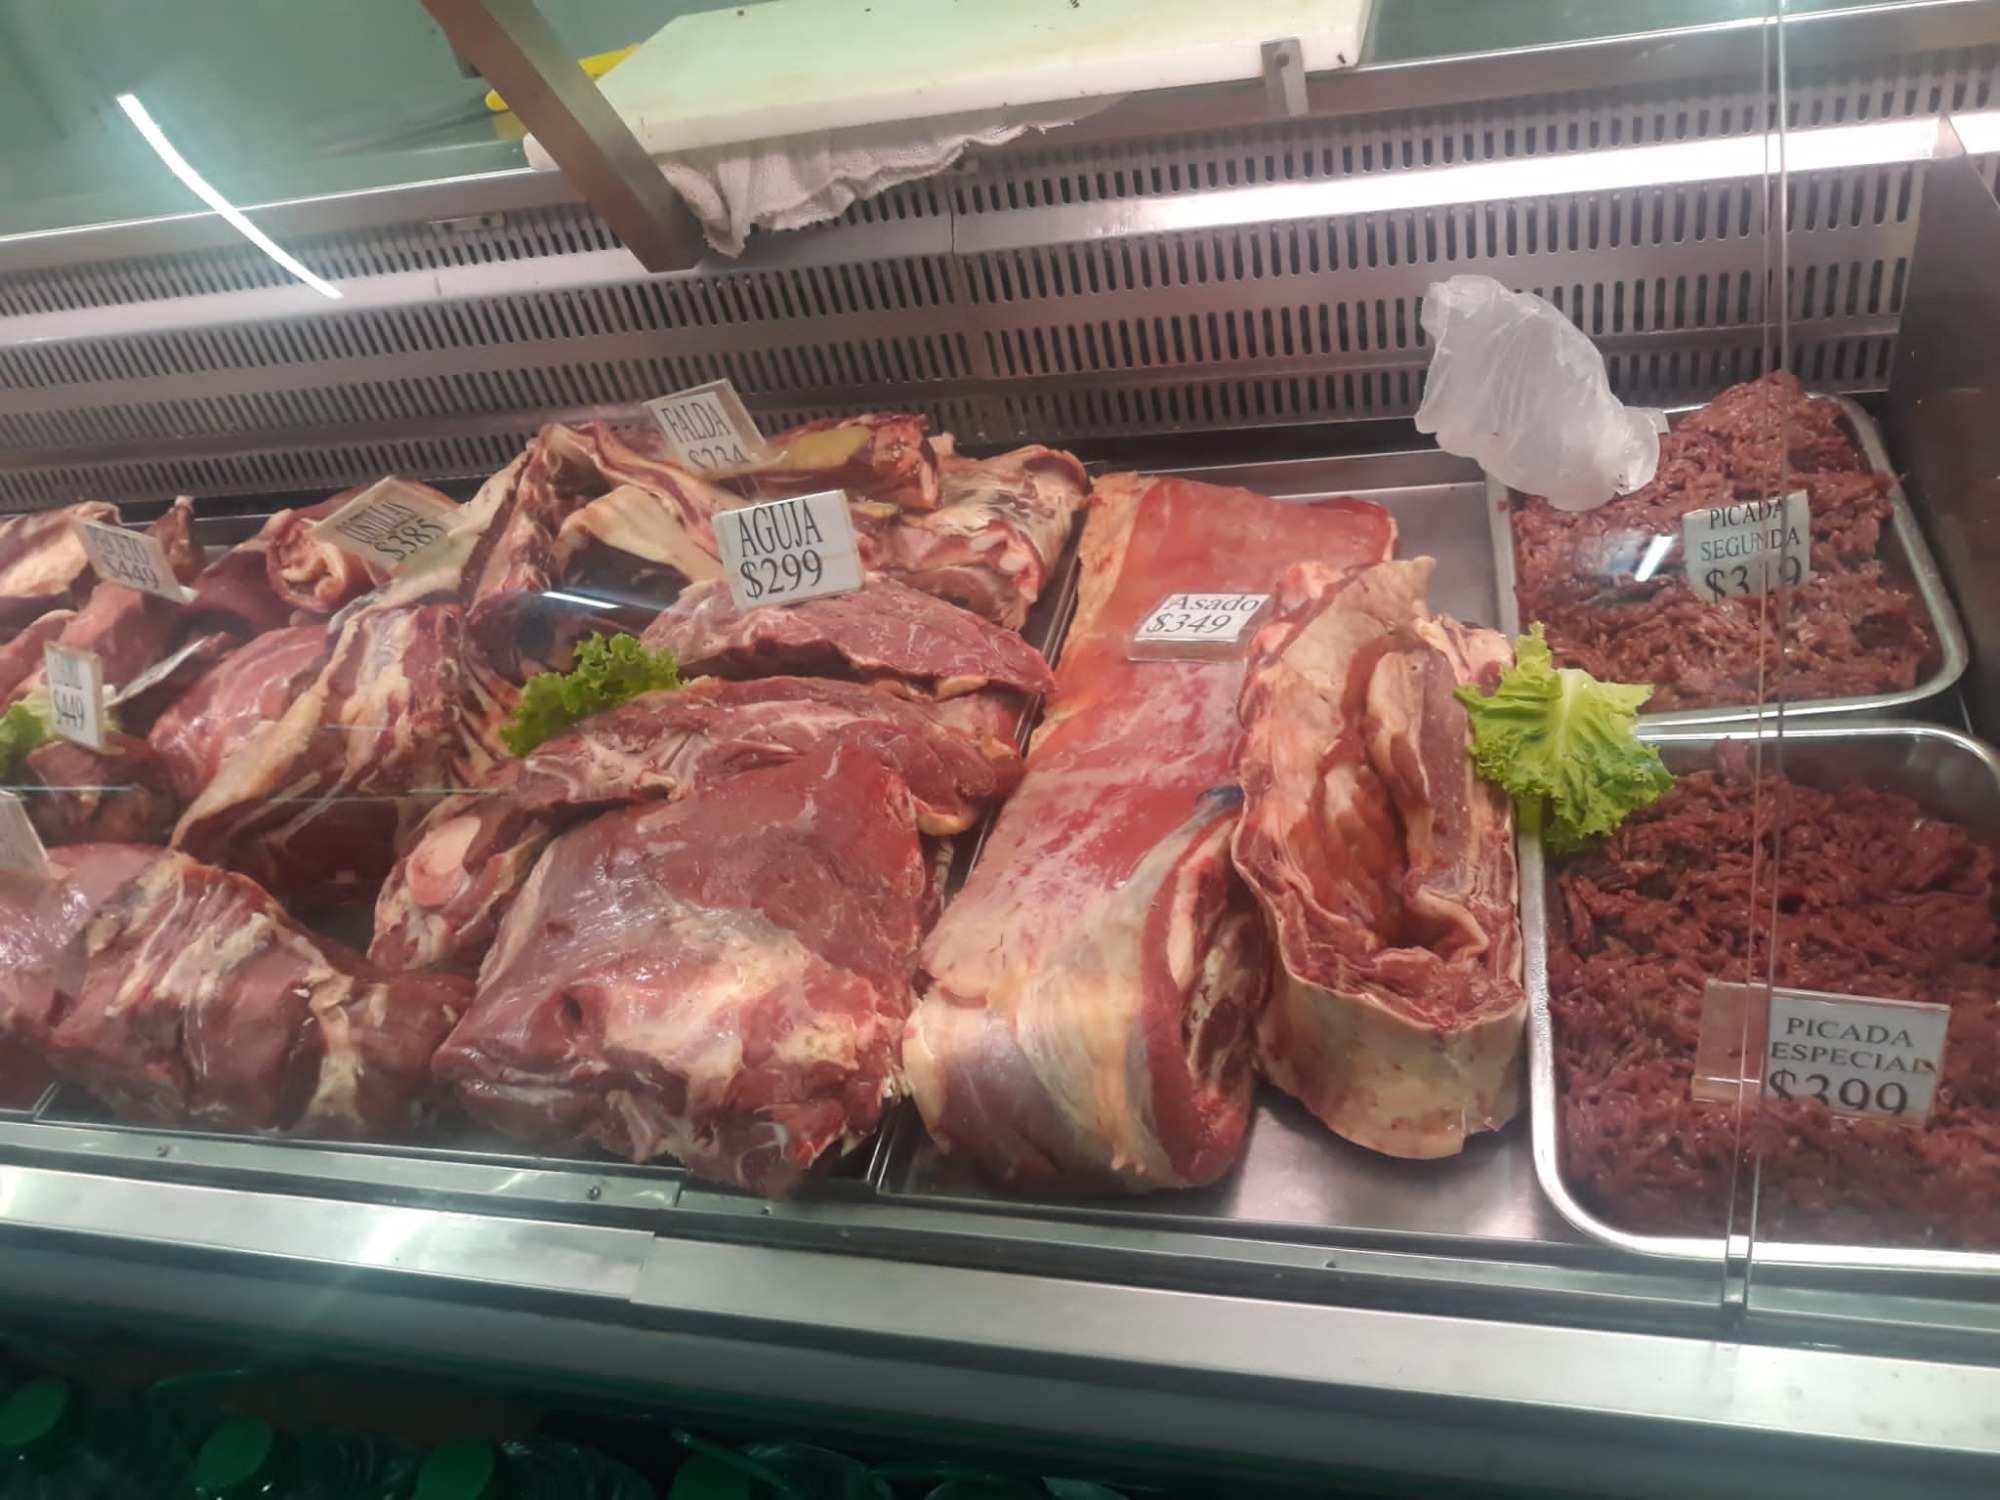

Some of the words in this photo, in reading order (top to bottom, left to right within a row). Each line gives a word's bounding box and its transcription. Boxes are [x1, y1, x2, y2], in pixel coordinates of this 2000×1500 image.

[661, 402, 732, 443] FALDA
[738, 498, 824, 558] AGUJA
[1709, 498, 1786, 530] PICADA
[375, 517, 446, 561] $385
[1700, 527, 1801, 562] SEGUNDA
[740, 550, 824, 600] $299
[1704, 556, 1803, 604] $39
[1163, 595, 1259, 612] Asado
[1146, 612, 1232, 634] $349
[1785, 1017, 1914, 1048] PICADA
